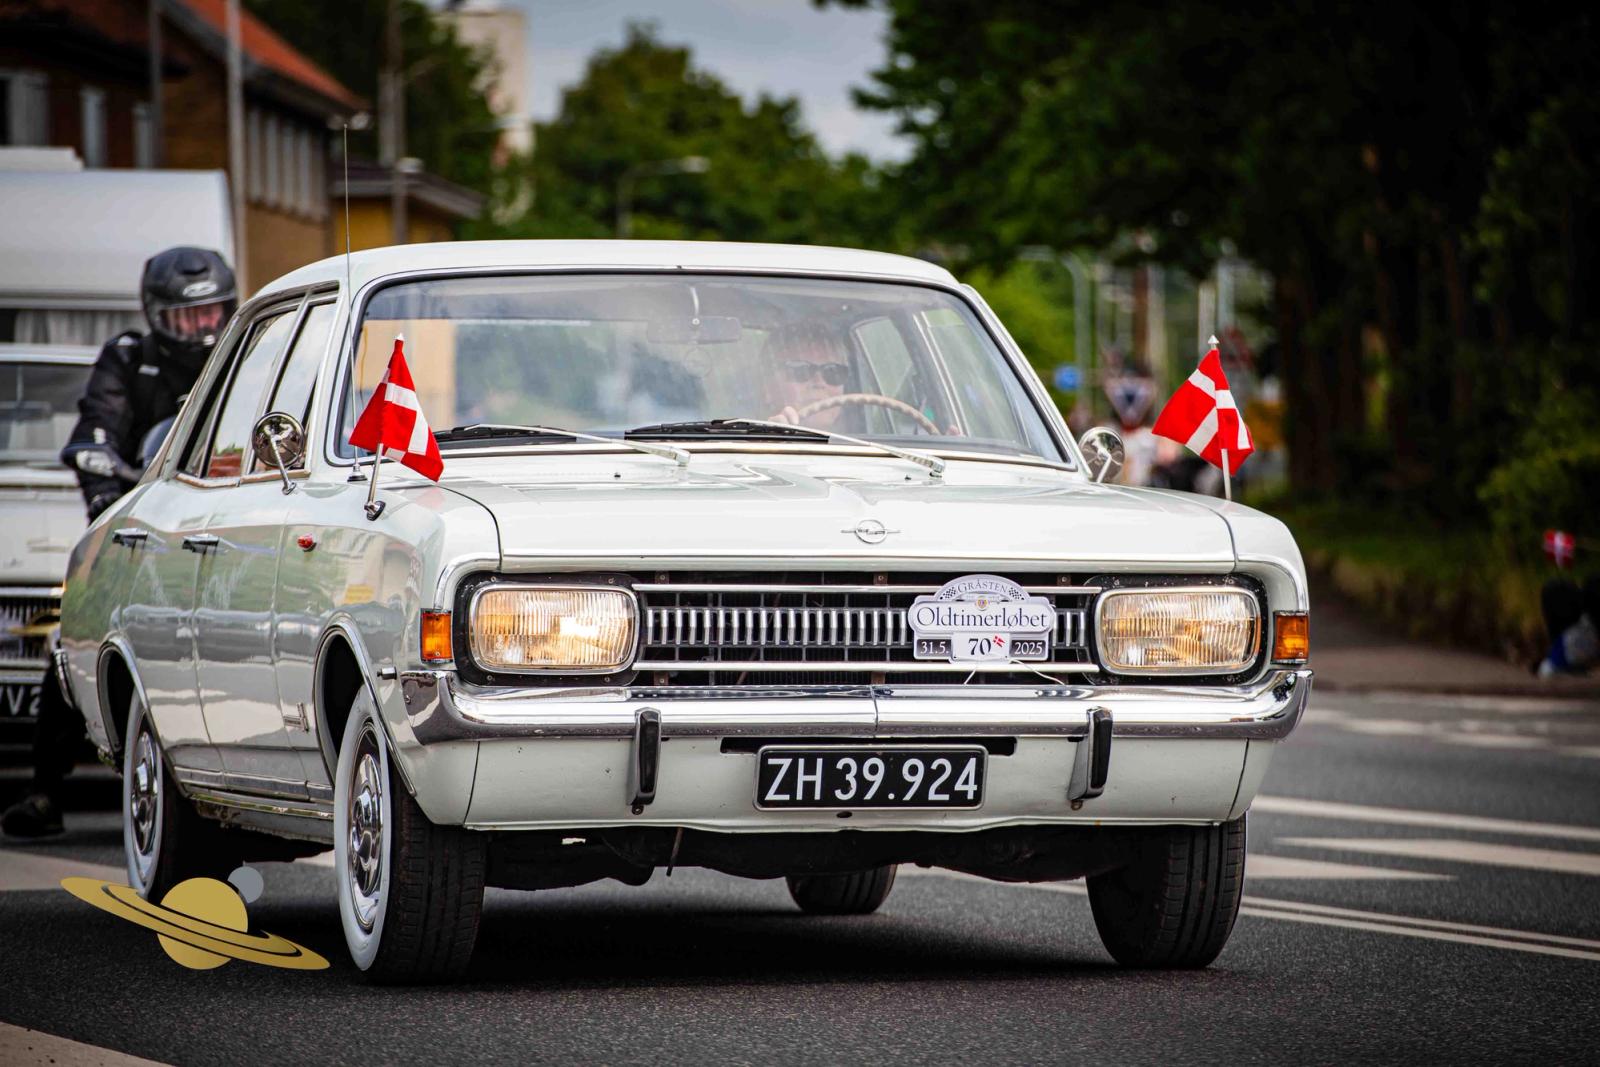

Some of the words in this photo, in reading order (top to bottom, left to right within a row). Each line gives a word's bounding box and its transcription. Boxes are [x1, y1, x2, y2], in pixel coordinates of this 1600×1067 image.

[957, 579, 1008, 593] GRÅSTEN
[916, 606, 1048, 629] Oldtimerløbet
[920, 642, 949, 655] 31.5.
[967, 638, 992, 656] 70
[1014, 642, 1043, 656] 2025
[764, 757, 823, 801] ZH
[834, 757, 978, 801] 39.924
